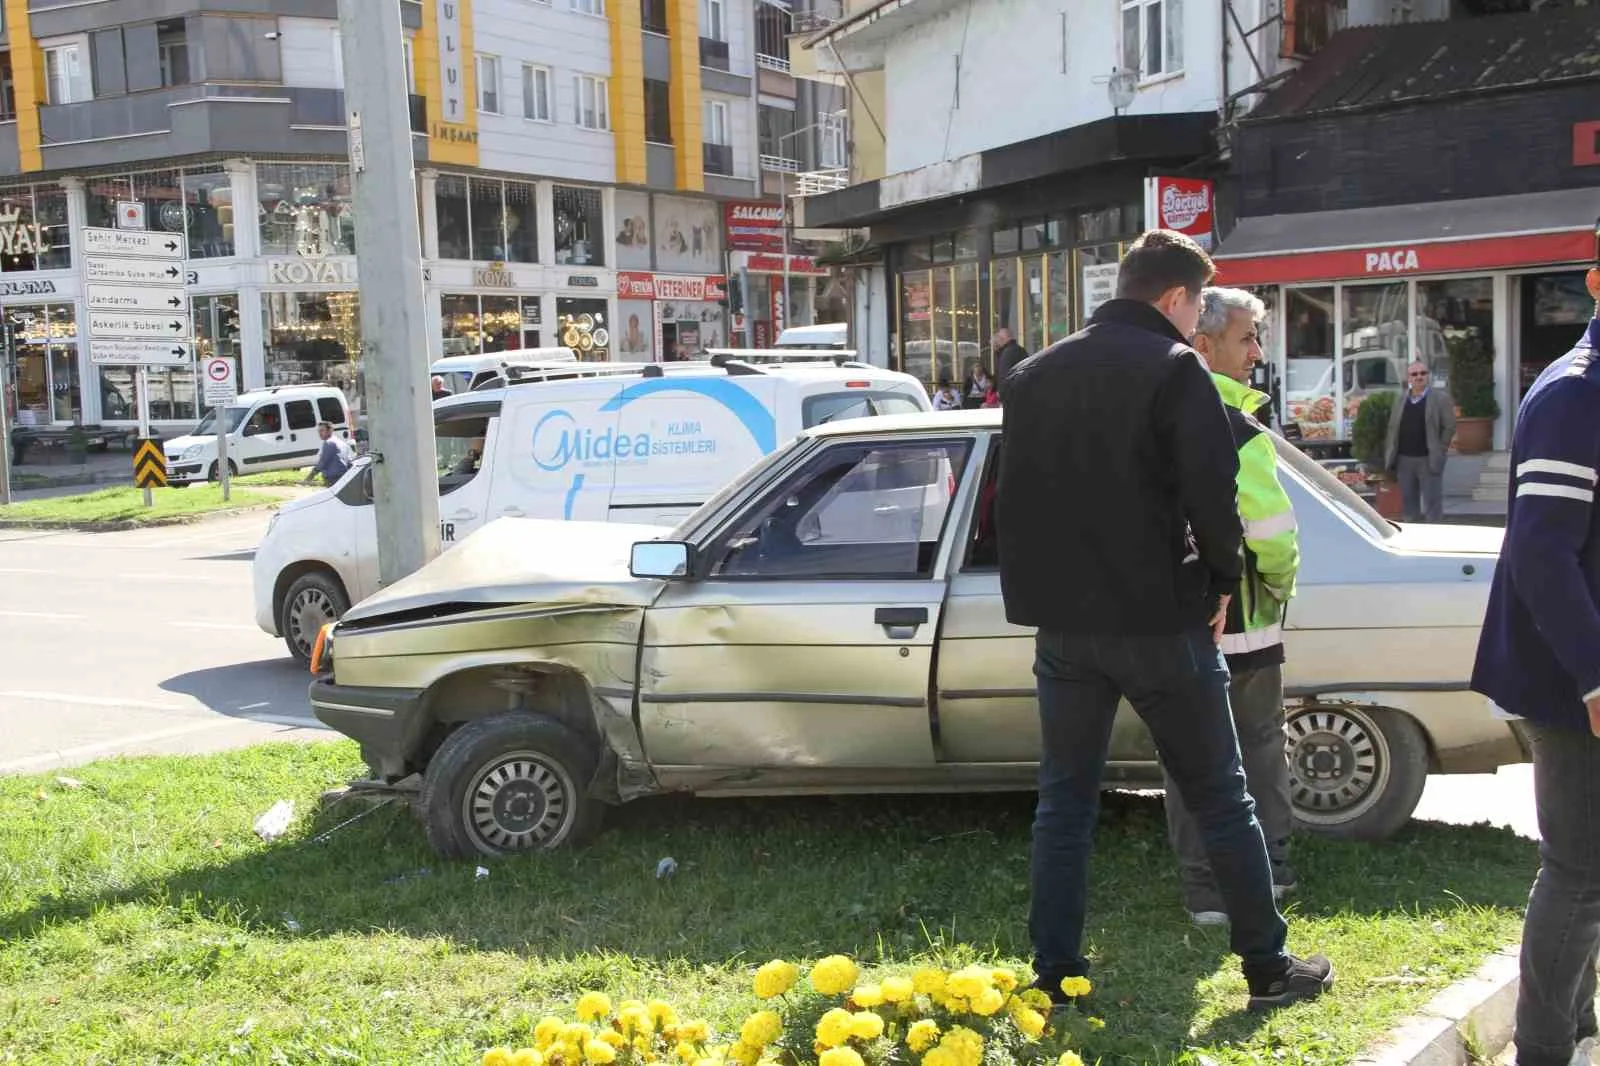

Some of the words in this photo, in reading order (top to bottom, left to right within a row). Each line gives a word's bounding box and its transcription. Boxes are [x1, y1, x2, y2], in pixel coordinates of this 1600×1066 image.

[115, 234, 150, 246] Merkezi
[1365, 250, 1419, 272] PAÇA
[269, 260, 357, 284] ROYAL
[473, 270, 517, 287] ROYAL
[90, 295, 138, 305] Jandarma
[93, 320, 129, 330] Askerlik
[133, 321, 164, 331] Şubesi
[548, 425, 651, 464] Midea
